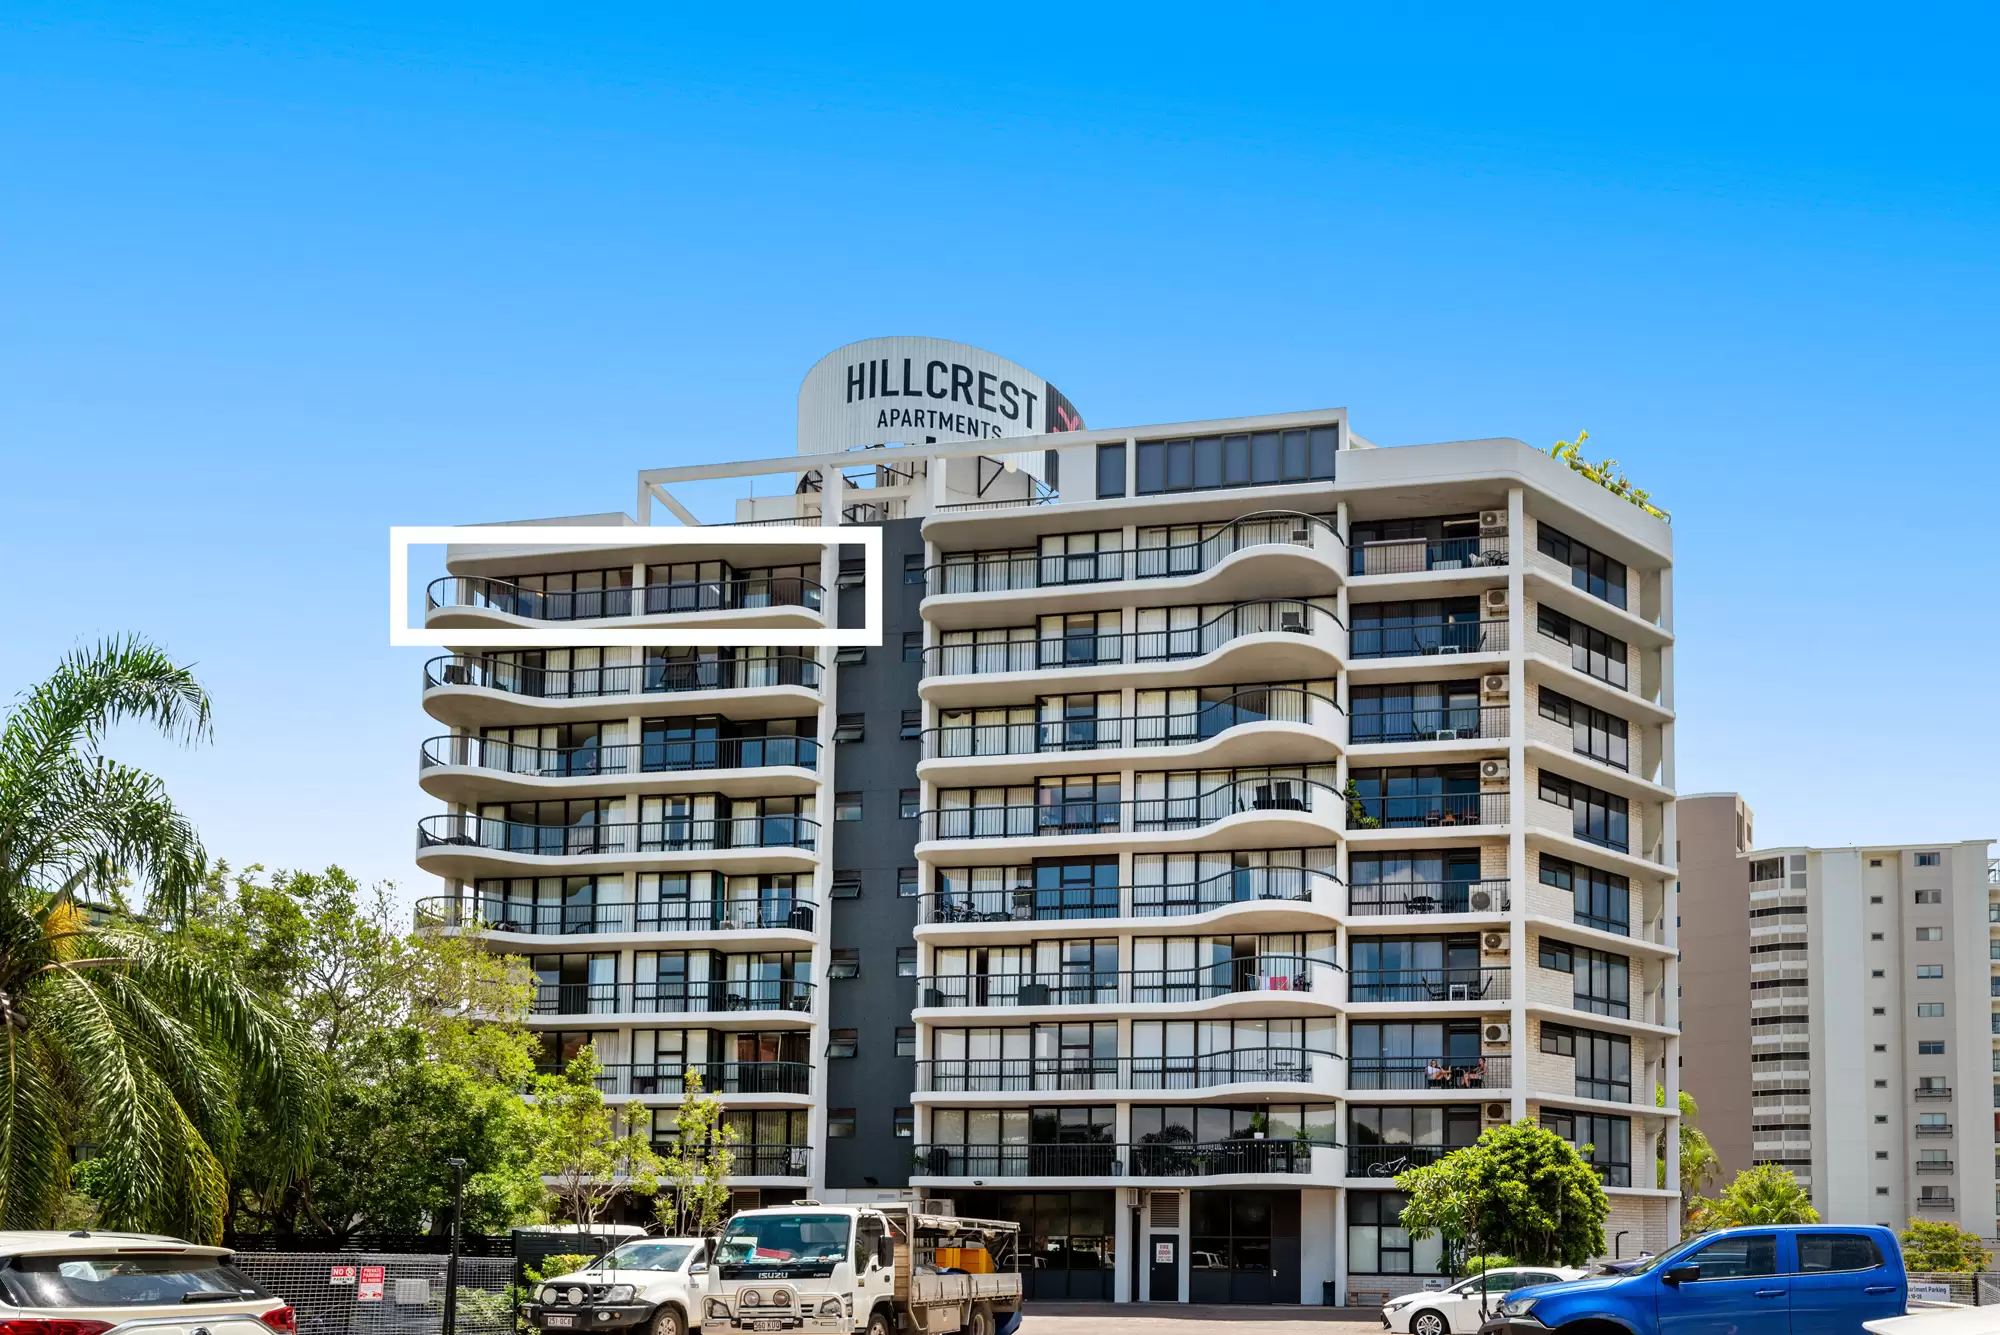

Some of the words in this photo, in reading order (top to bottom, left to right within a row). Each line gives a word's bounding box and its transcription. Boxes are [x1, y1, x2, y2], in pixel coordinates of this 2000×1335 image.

[847, 358, 1037, 429] HILLCREST
[877, 408, 1002, 438] APARTMENTS
[1929, 1286, 1946, 1294] Parking
